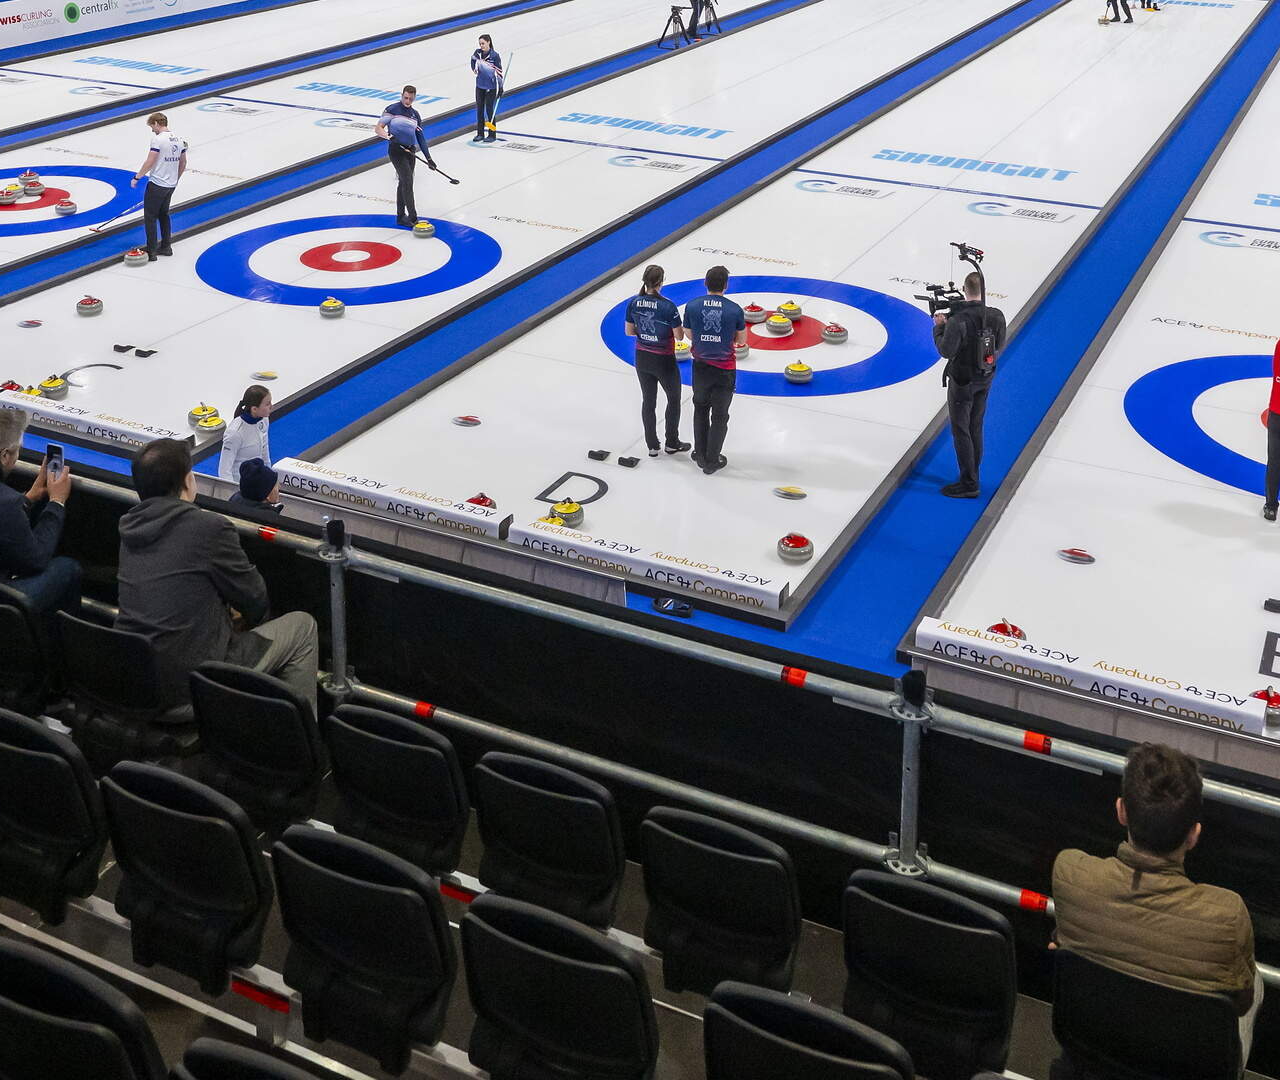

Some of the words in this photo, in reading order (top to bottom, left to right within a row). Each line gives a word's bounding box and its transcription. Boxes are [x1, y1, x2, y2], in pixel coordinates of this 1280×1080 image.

[693, 246, 720, 256] ACE
[735, 253, 799, 268] Company
[887, 276, 914, 286] ACE
[636, 298, 659, 310] KLÍMOVÁ
[703, 299, 722, 309] KLÍMA
[700, 334, 722, 343] CZECHIA
[1151, 316, 1187, 328] ACE
[1206, 323, 1280, 342] Compan
[293, 459, 346, 482] Company
[282, 474, 308, 490] ACE
[320, 483, 377, 510] Company
[360, 478, 387, 491] ACE
[535, 471, 609, 506] D
[394, 485, 454, 510] Company
[386, 501, 412, 518] ACE
[427, 511, 488, 538] Company
[465, 505, 497, 518] ACE
[521, 536, 551, 554] ACE
[566, 548, 633, 577] Company
[650, 549, 721, 575] Company
[645, 567, 676, 586] ACE
[692, 579, 767, 610] Company
[735, 572, 772, 587] ACE
[937, 620, 1019, 650] Company
[931, 640, 970, 661] ACE
[989, 653, 1075, 689] Company
[1040, 646, 1080, 664] ACE
[1093, 659, 1182, 691] Company
[1089, 680, 1129, 701] ACE
[1150, 696, 1245, 733] Company
[1204, 688, 1248, 707] ACE
